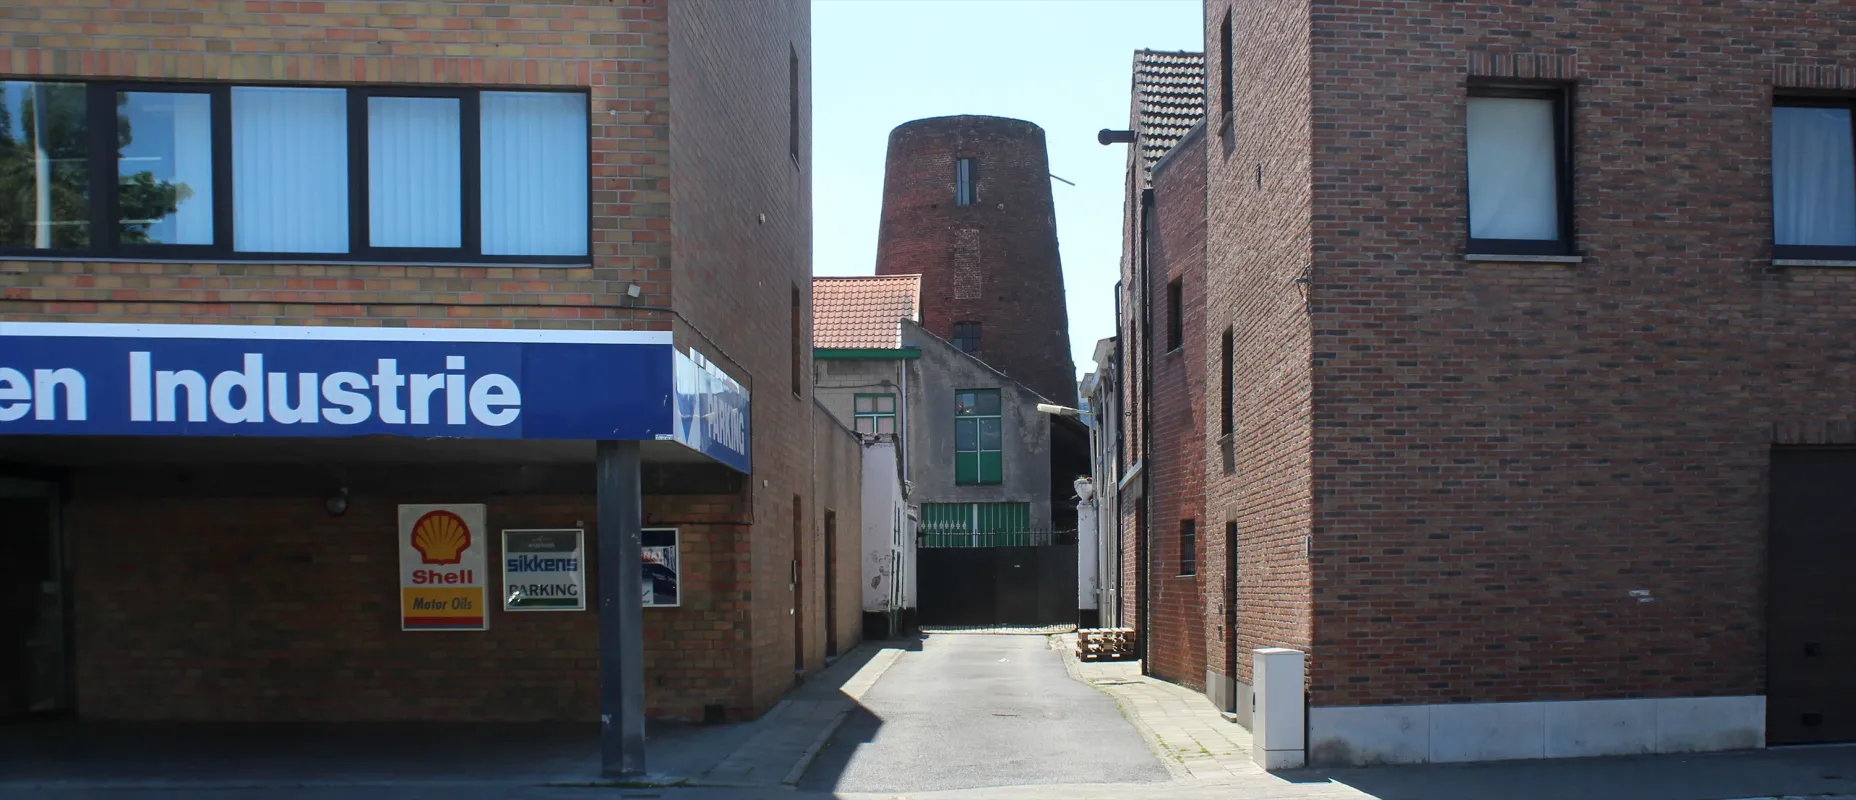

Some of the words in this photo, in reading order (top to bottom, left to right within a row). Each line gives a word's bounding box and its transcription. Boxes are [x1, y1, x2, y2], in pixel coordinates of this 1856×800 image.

[129, 351, 521, 427] Industrie
[707, 391, 745, 456] PARKING
[507, 555, 578, 573] sikkens
[412, 569, 473, 585] Shell
[509, 584, 578, 597] PARKING
[412, 597, 449, 610] Motor
[451, 597, 473, 610] Oils
